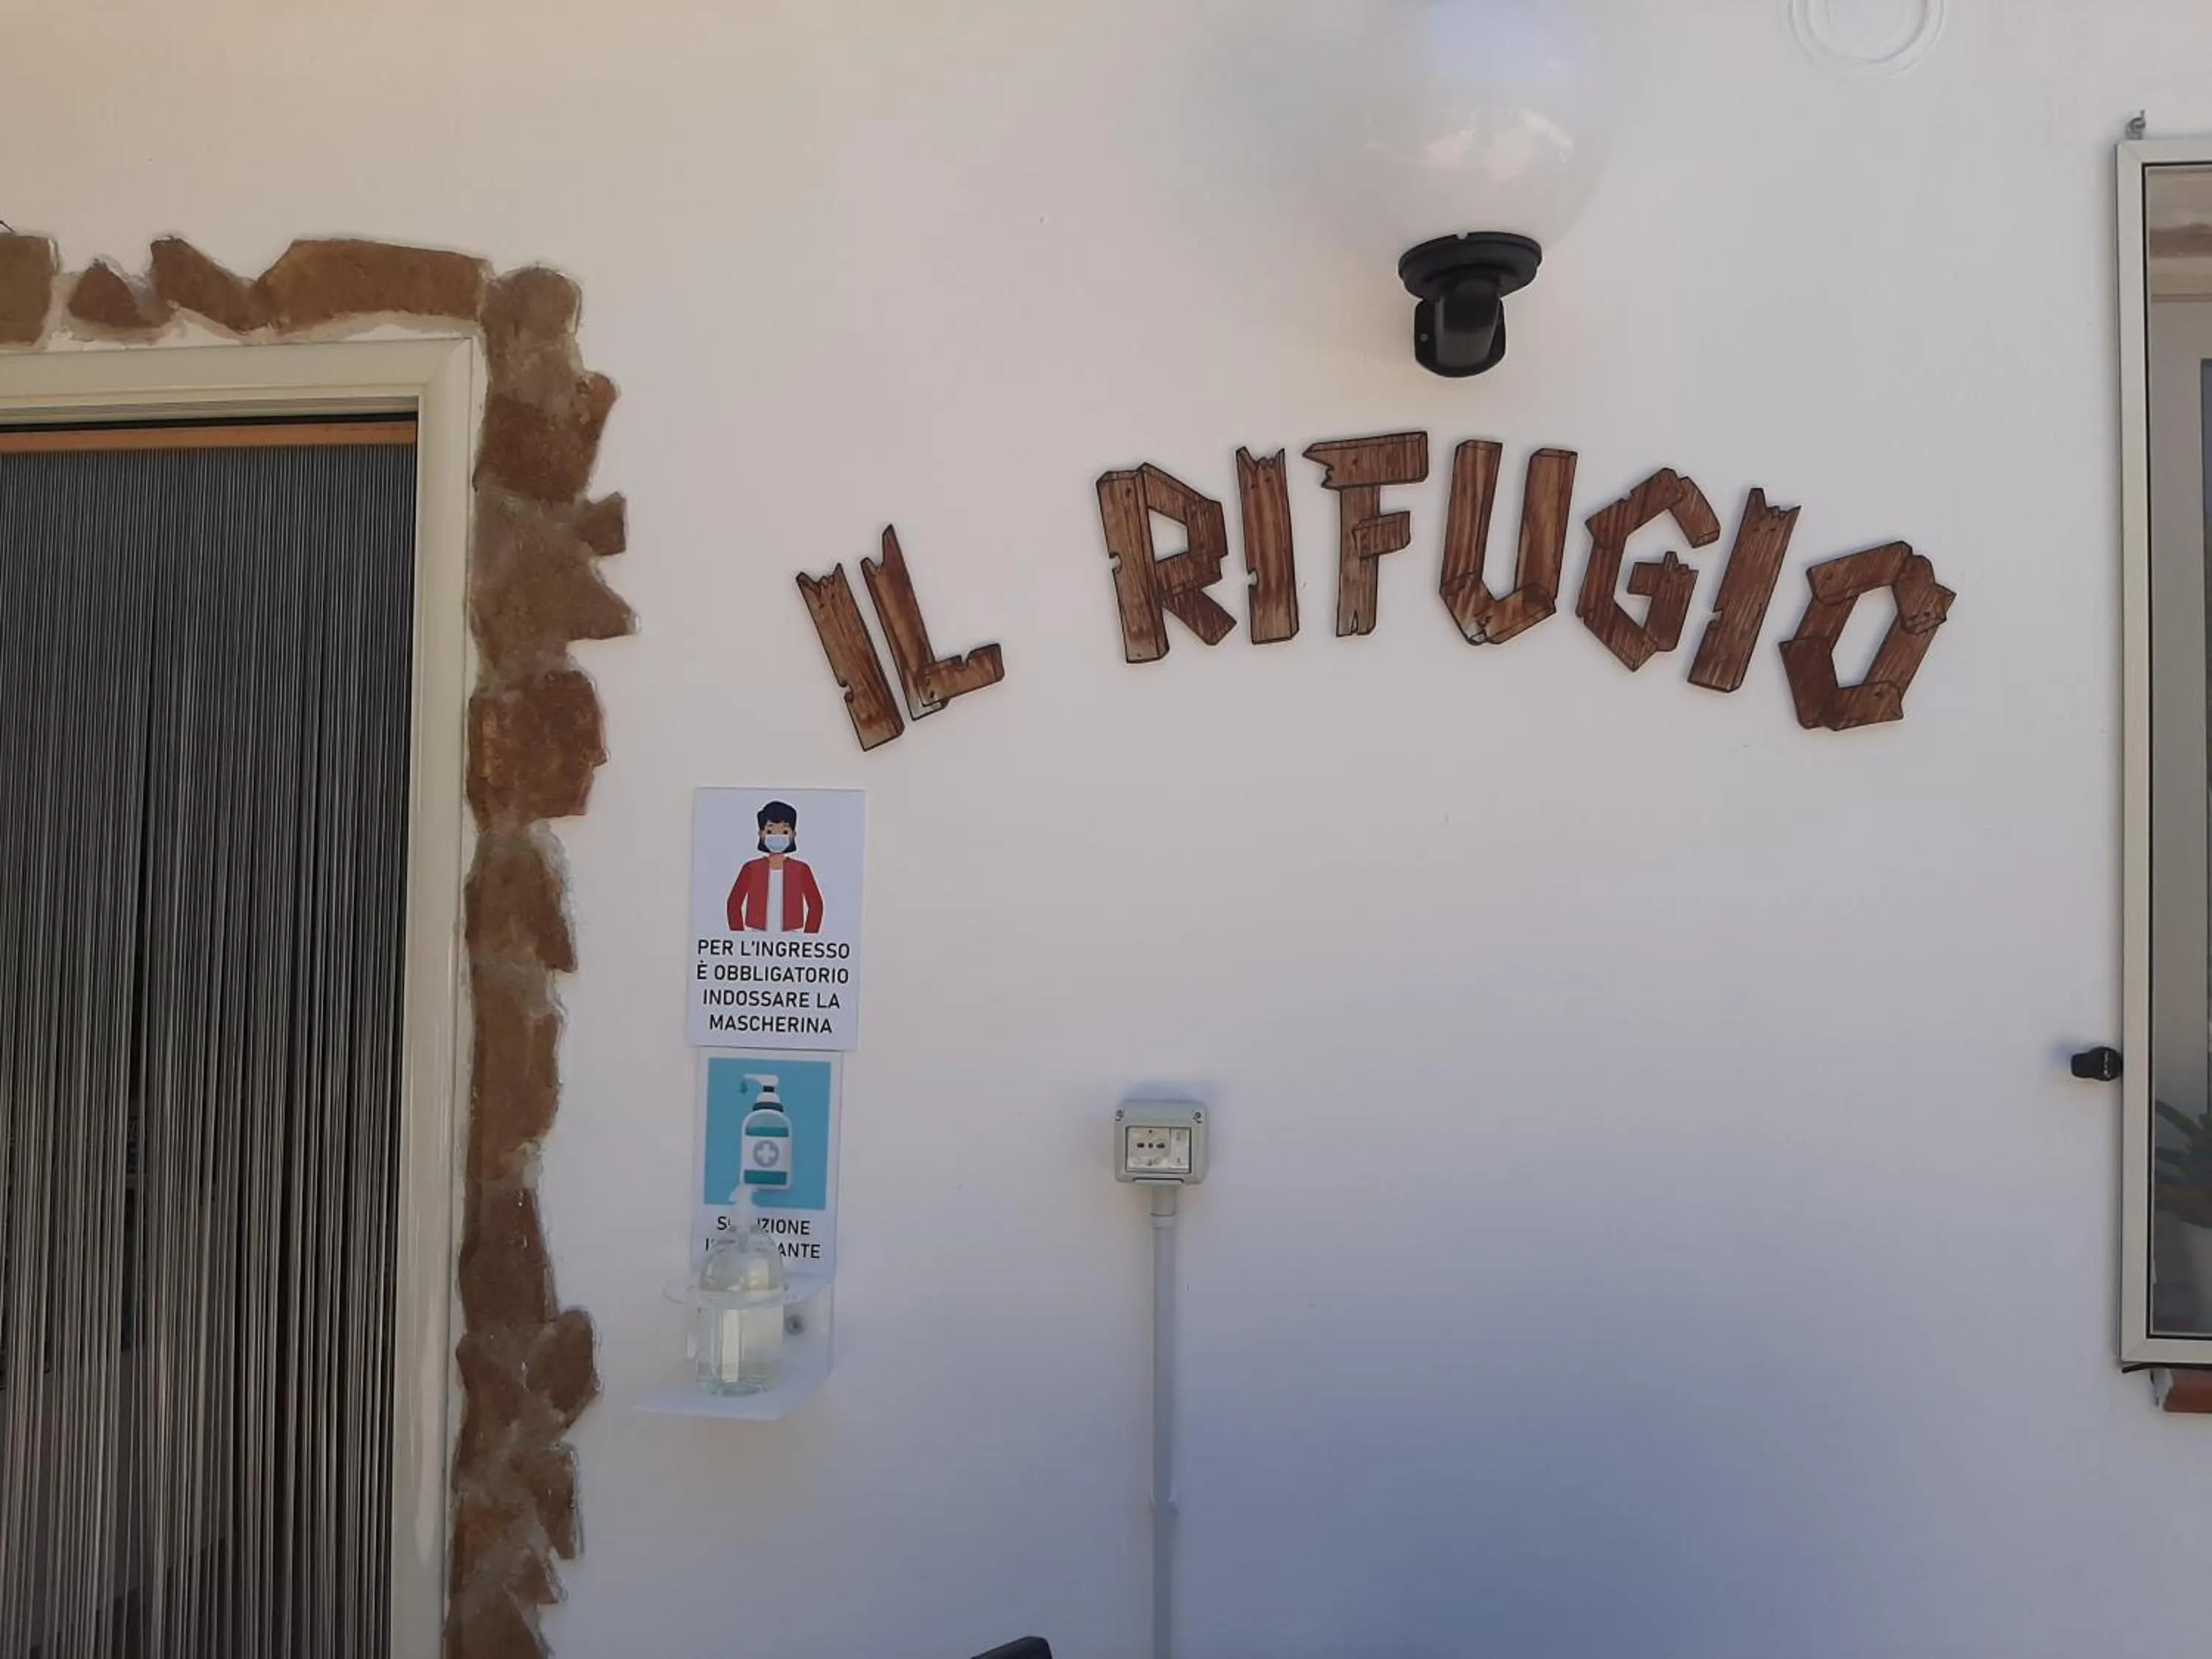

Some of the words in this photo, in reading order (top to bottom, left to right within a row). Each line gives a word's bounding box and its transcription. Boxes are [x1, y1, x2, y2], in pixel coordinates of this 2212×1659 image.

[795, 524, 1005, 751] IL
[1096, 430, 1956, 731] RIFUGIO
[698, 939, 734, 956] PER
[741, 941, 850, 959] L'INGRESSO
[698, 960, 708, 981] È
[714, 964, 849, 984] OBBLIGATORIO
[703, 989, 810, 1007] INDOSSARE
[816, 992, 840, 1009] LA
[709, 1014, 832, 1033] MASCHERINA
[717, 1216, 810, 1235] SZIONE
